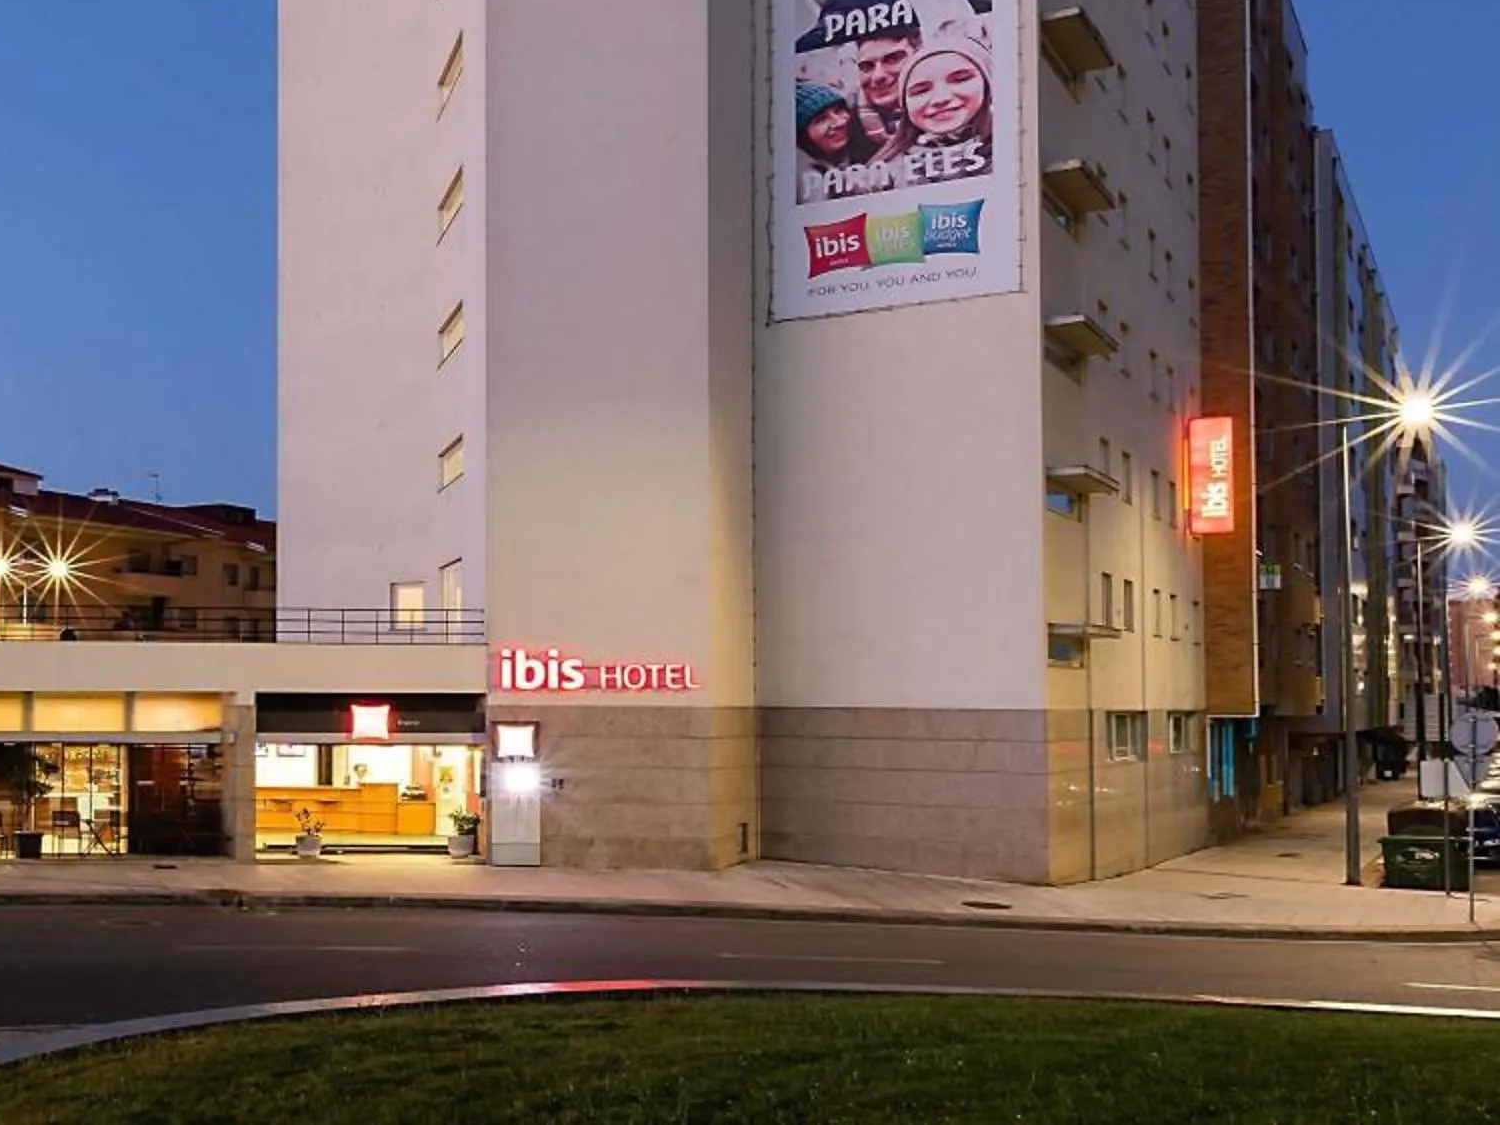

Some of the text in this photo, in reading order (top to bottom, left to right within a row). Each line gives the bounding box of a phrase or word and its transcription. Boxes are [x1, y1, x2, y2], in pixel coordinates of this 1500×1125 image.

[825, 0, 913, 41] PARA
[803, 138, 985, 198] PARA ELES
[930, 212, 968, 229] ibis
[815, 232, 861, 259] ibis
[910, 271, 942, 284] AND
[1201, 435, 1229, 518] ibis HOTEL
[501, 648, 701, 690] ibis HOTEL
